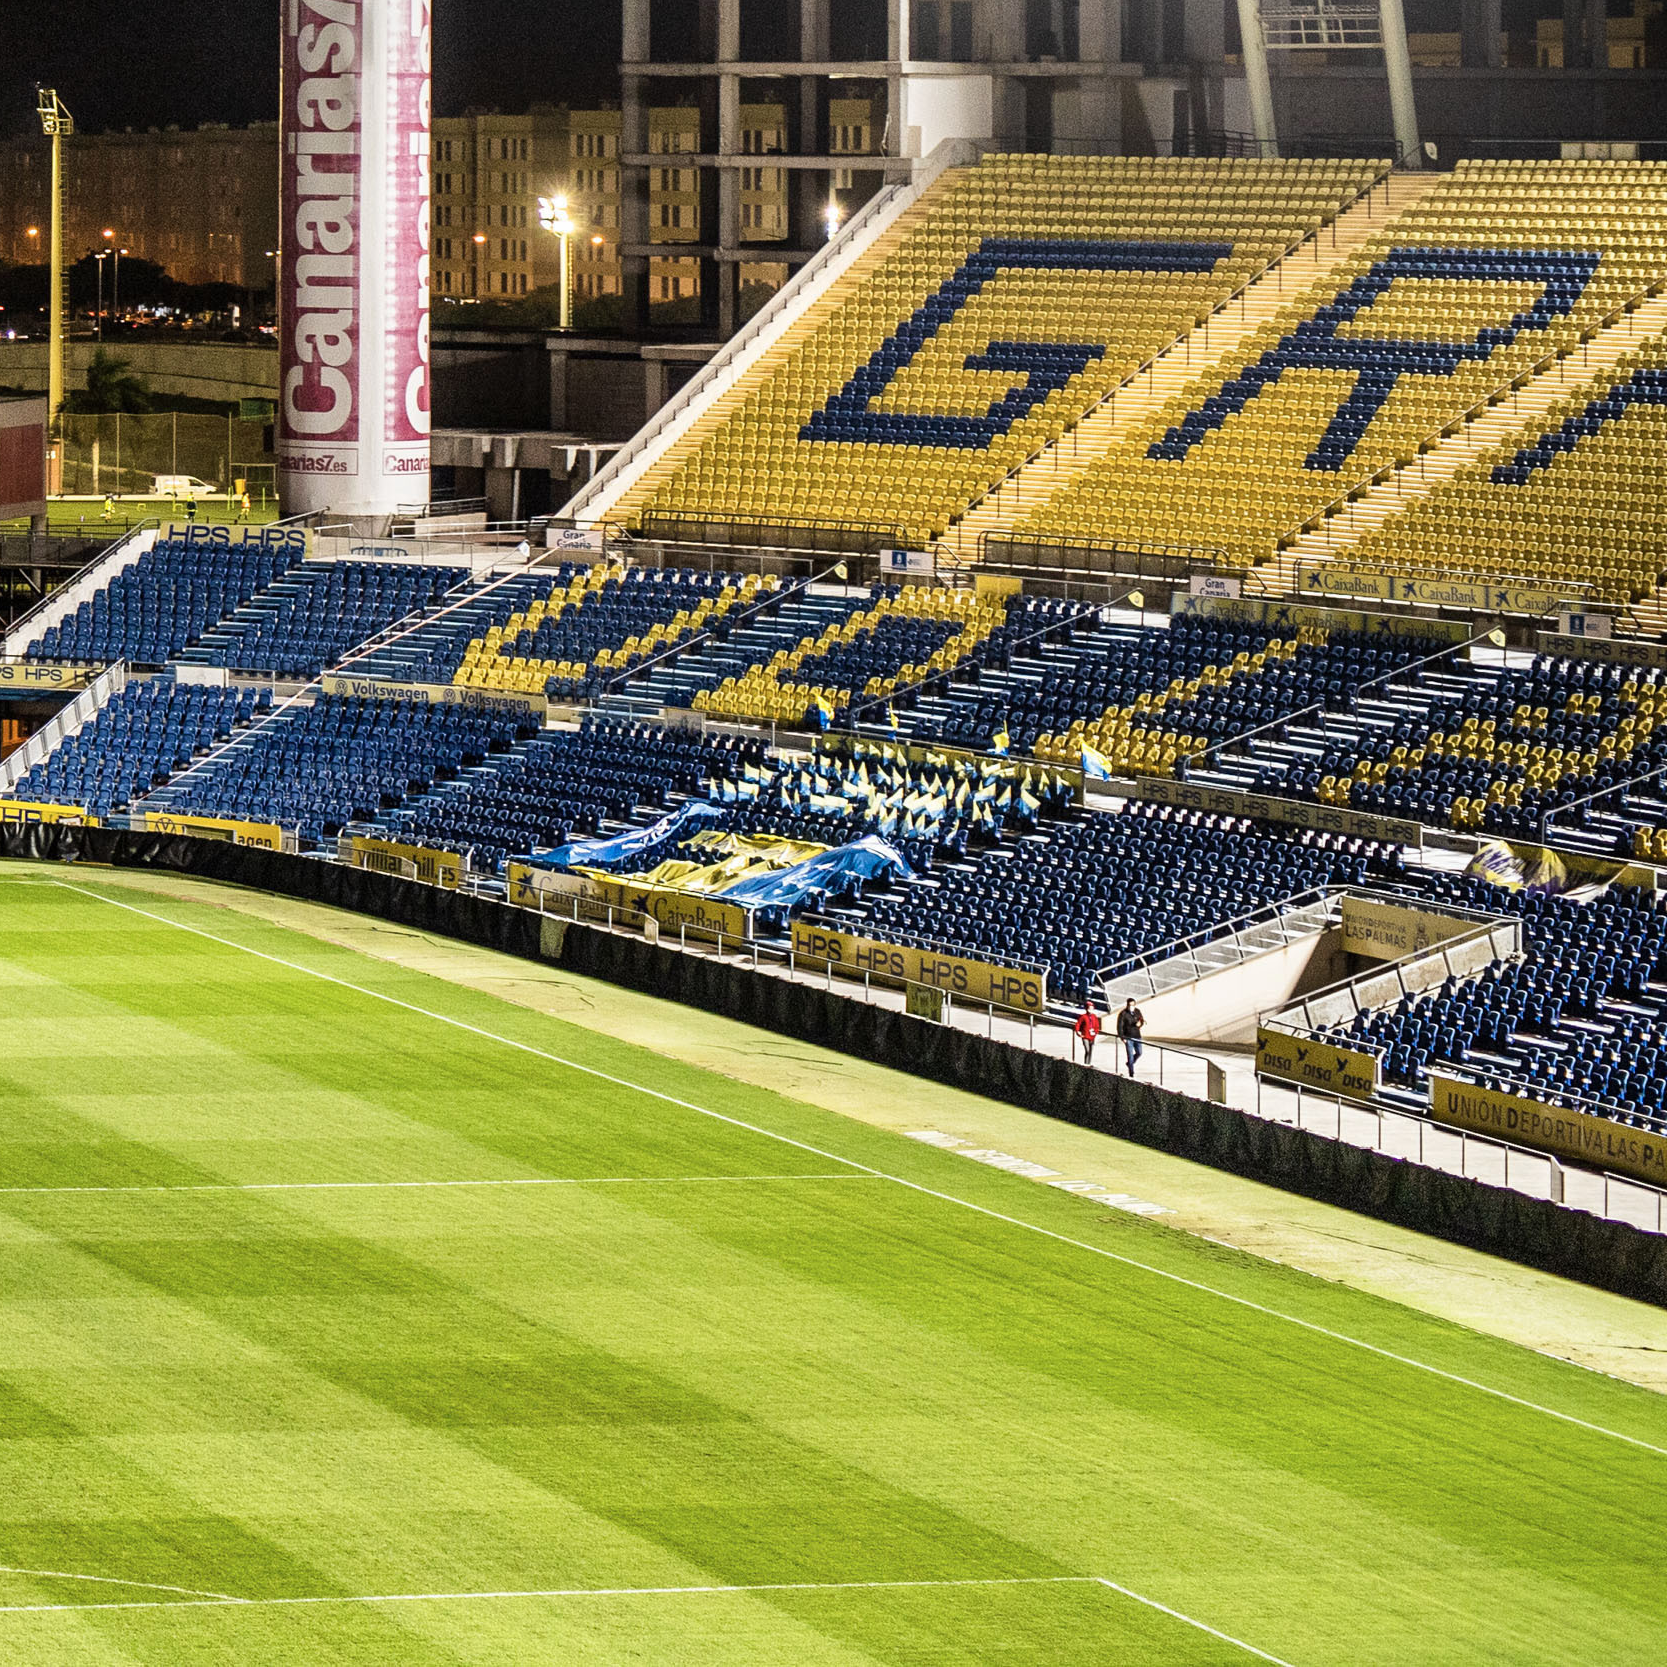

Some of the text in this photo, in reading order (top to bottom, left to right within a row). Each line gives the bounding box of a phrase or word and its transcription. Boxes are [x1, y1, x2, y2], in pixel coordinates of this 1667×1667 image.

[168, 524, 306, 548] HPS HPS
[1205, 578, 1226, 589] Gran
[1323, 574, 1380, 595] CaixaBank
[1418, 583, 1478, 605] CaixaBank
[25, 667, 63, 682] HPS
[351, 681, 531, 711] Volkswagen Volkswagen
[654, 897, 730, 935] CaixaBank
[796, 931, 1039, 1008] HPS HPS HPS HPS
